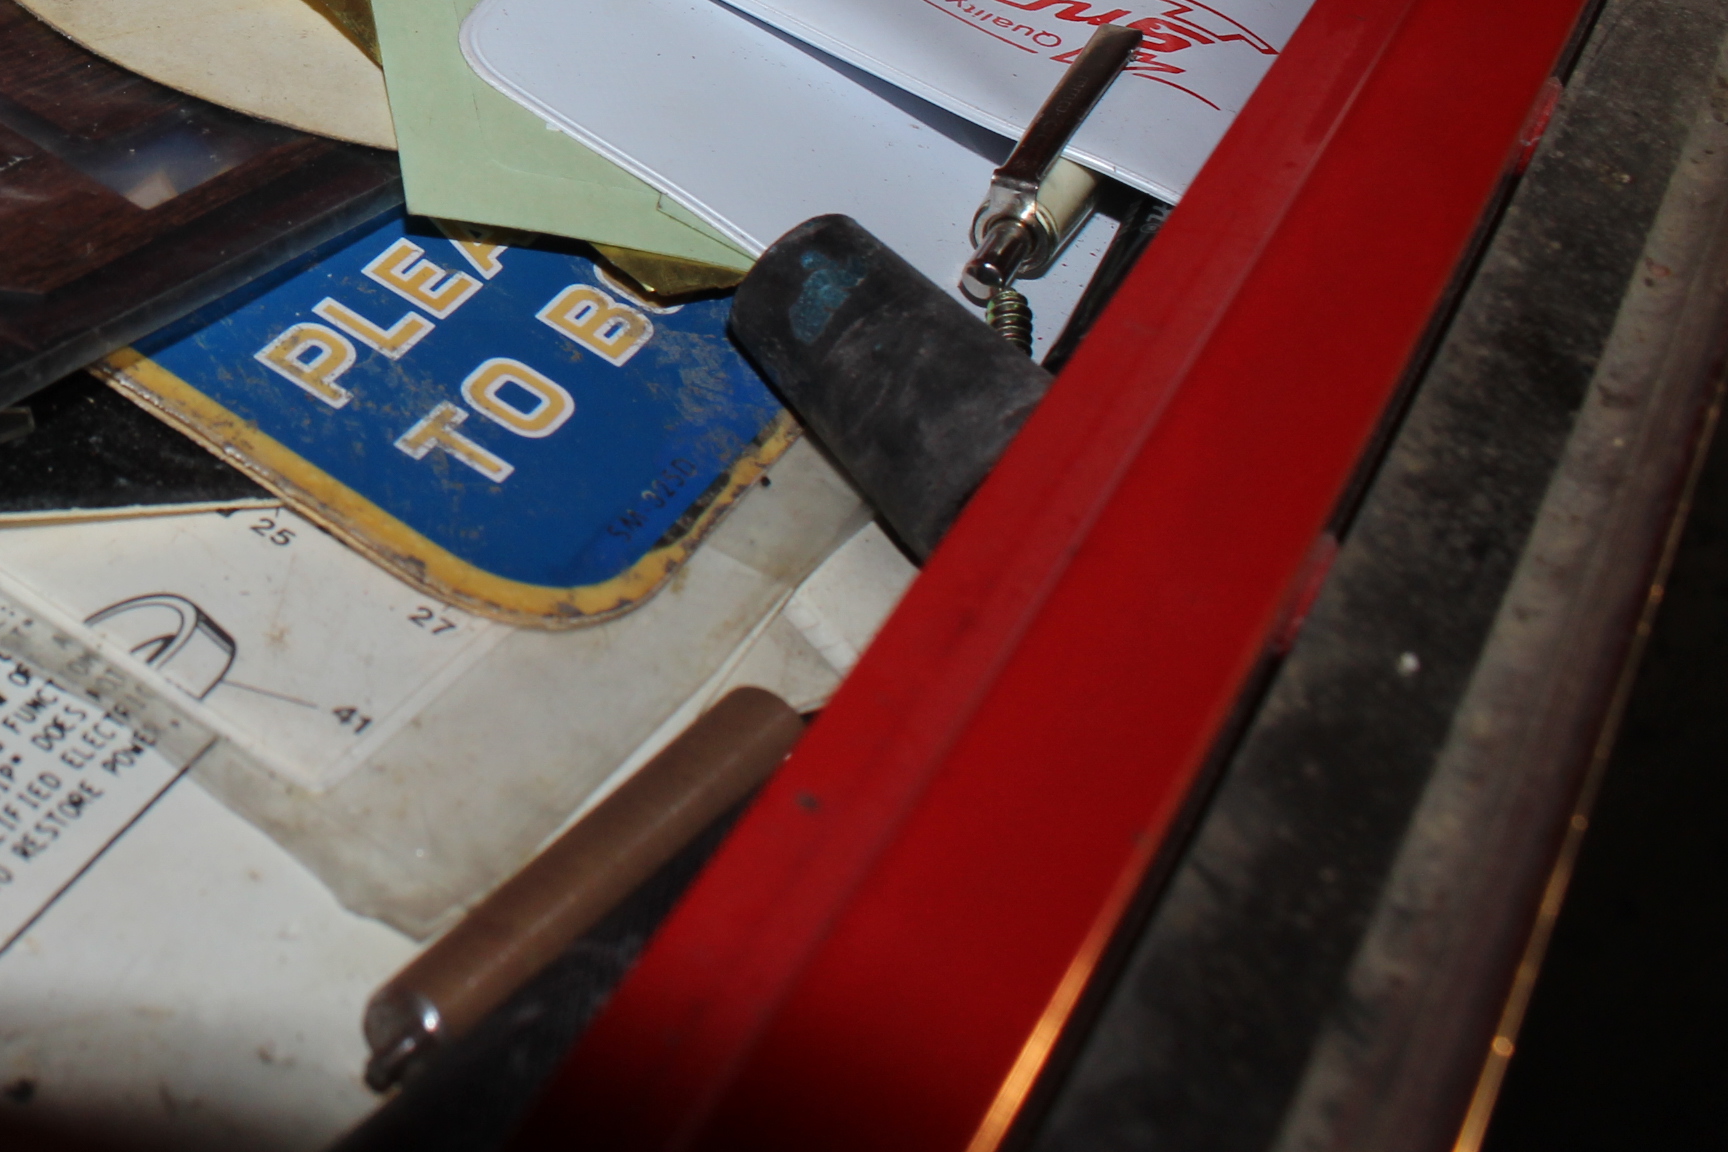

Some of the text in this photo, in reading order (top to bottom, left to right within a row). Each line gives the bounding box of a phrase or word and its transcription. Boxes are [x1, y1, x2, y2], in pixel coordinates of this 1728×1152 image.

[253, 220, 510, 410] PLEA
[393, 356, 575, 484] TO
[249, 515, 297, 548] 25
[407, 605, 458, 638] 27
[330, 704, 375, 736] 41
